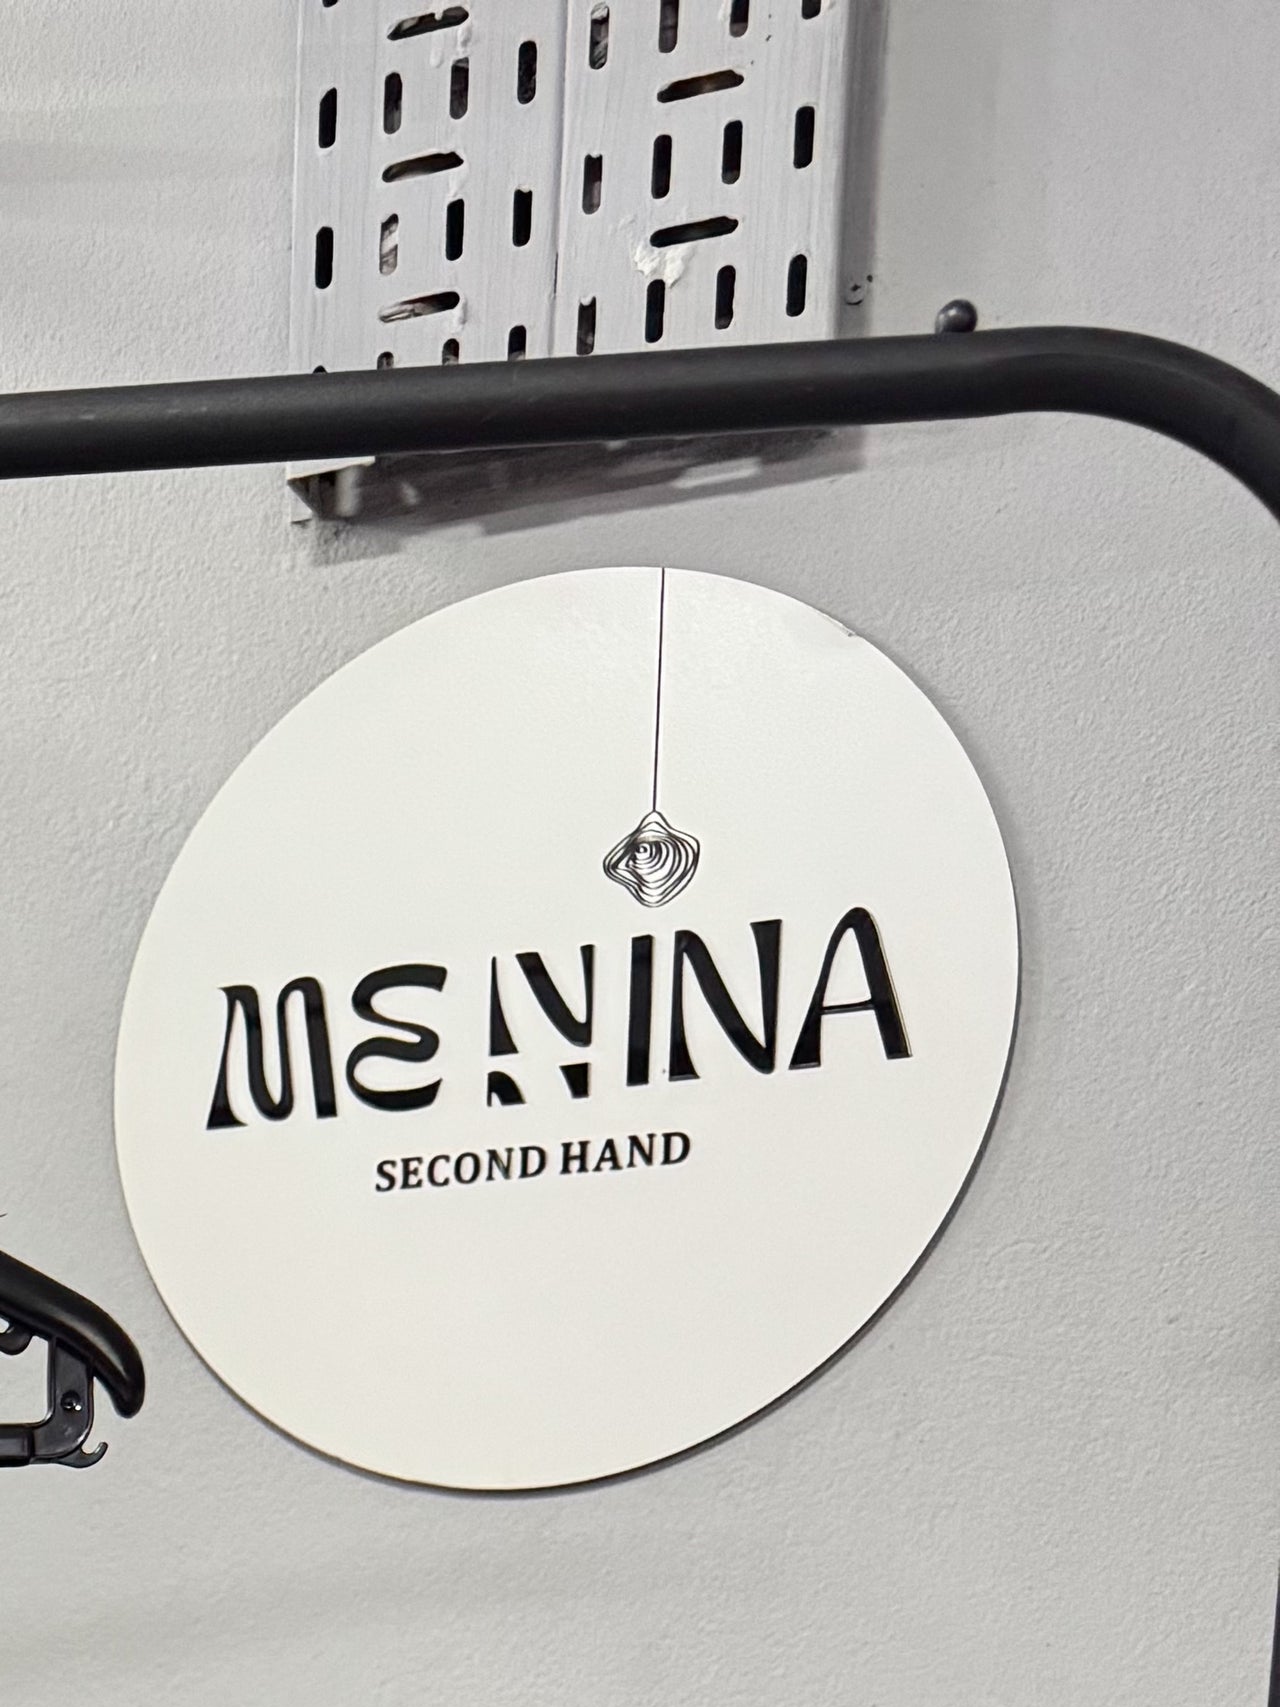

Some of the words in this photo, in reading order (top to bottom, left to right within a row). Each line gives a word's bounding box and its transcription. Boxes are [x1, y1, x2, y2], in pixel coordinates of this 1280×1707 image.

[205, 905, 914, 1131] MENINA
[374, 1144, 548, 1193] SECOND
[559, 1130, 692, 1176] HAND
